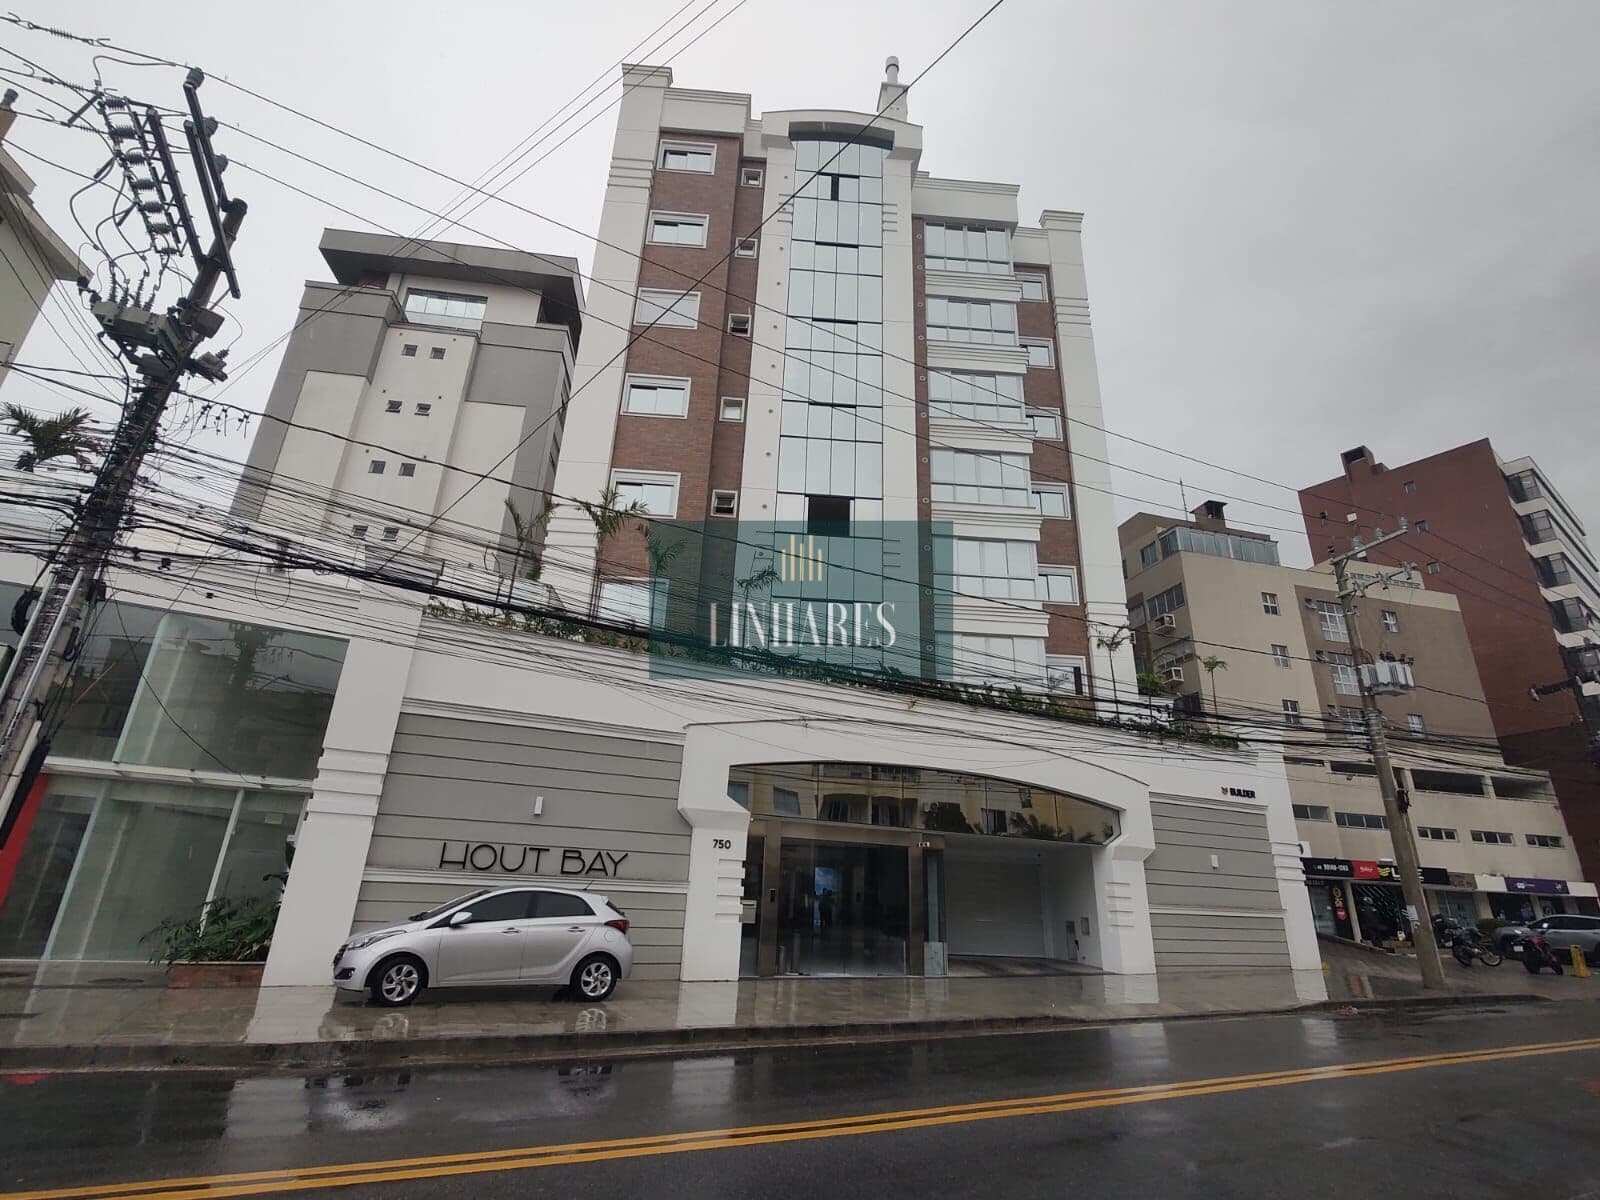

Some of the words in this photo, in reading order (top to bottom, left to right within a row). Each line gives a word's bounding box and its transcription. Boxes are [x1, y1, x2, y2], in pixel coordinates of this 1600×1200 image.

[712, 838, 732, 850] 750
[439, 842, 550, 872] HOUT
[560, 849, 629, 877] BAY
